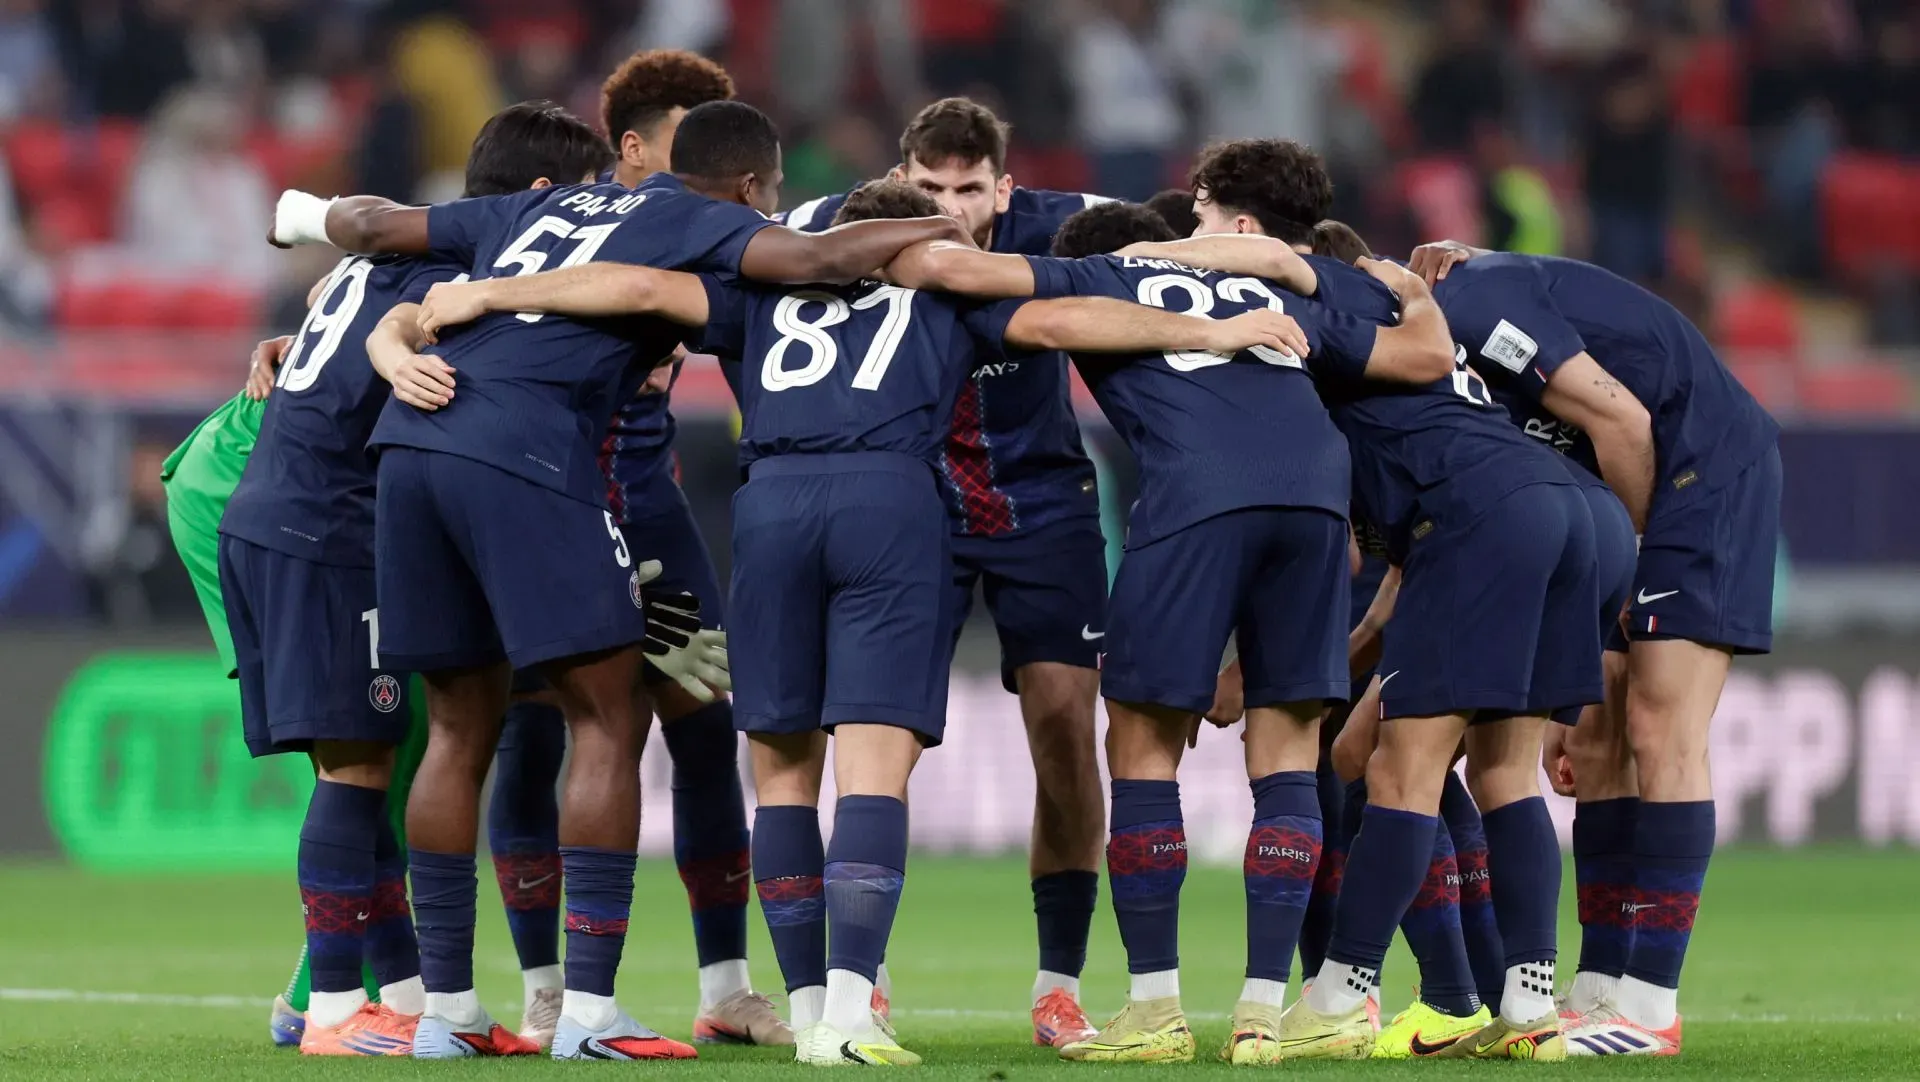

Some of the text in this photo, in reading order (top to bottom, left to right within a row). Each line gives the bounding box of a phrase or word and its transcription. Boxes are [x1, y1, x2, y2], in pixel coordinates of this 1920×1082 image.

[276, 253, 375, 392] 19
[761, 284, 918, 392] 87
[603, 509, 631, 568] 5
[374, 676, 396, 687] PARIS
[1153, 841, 1188, 854] PARI
[1258, 845, 1311, 863] PARIS
